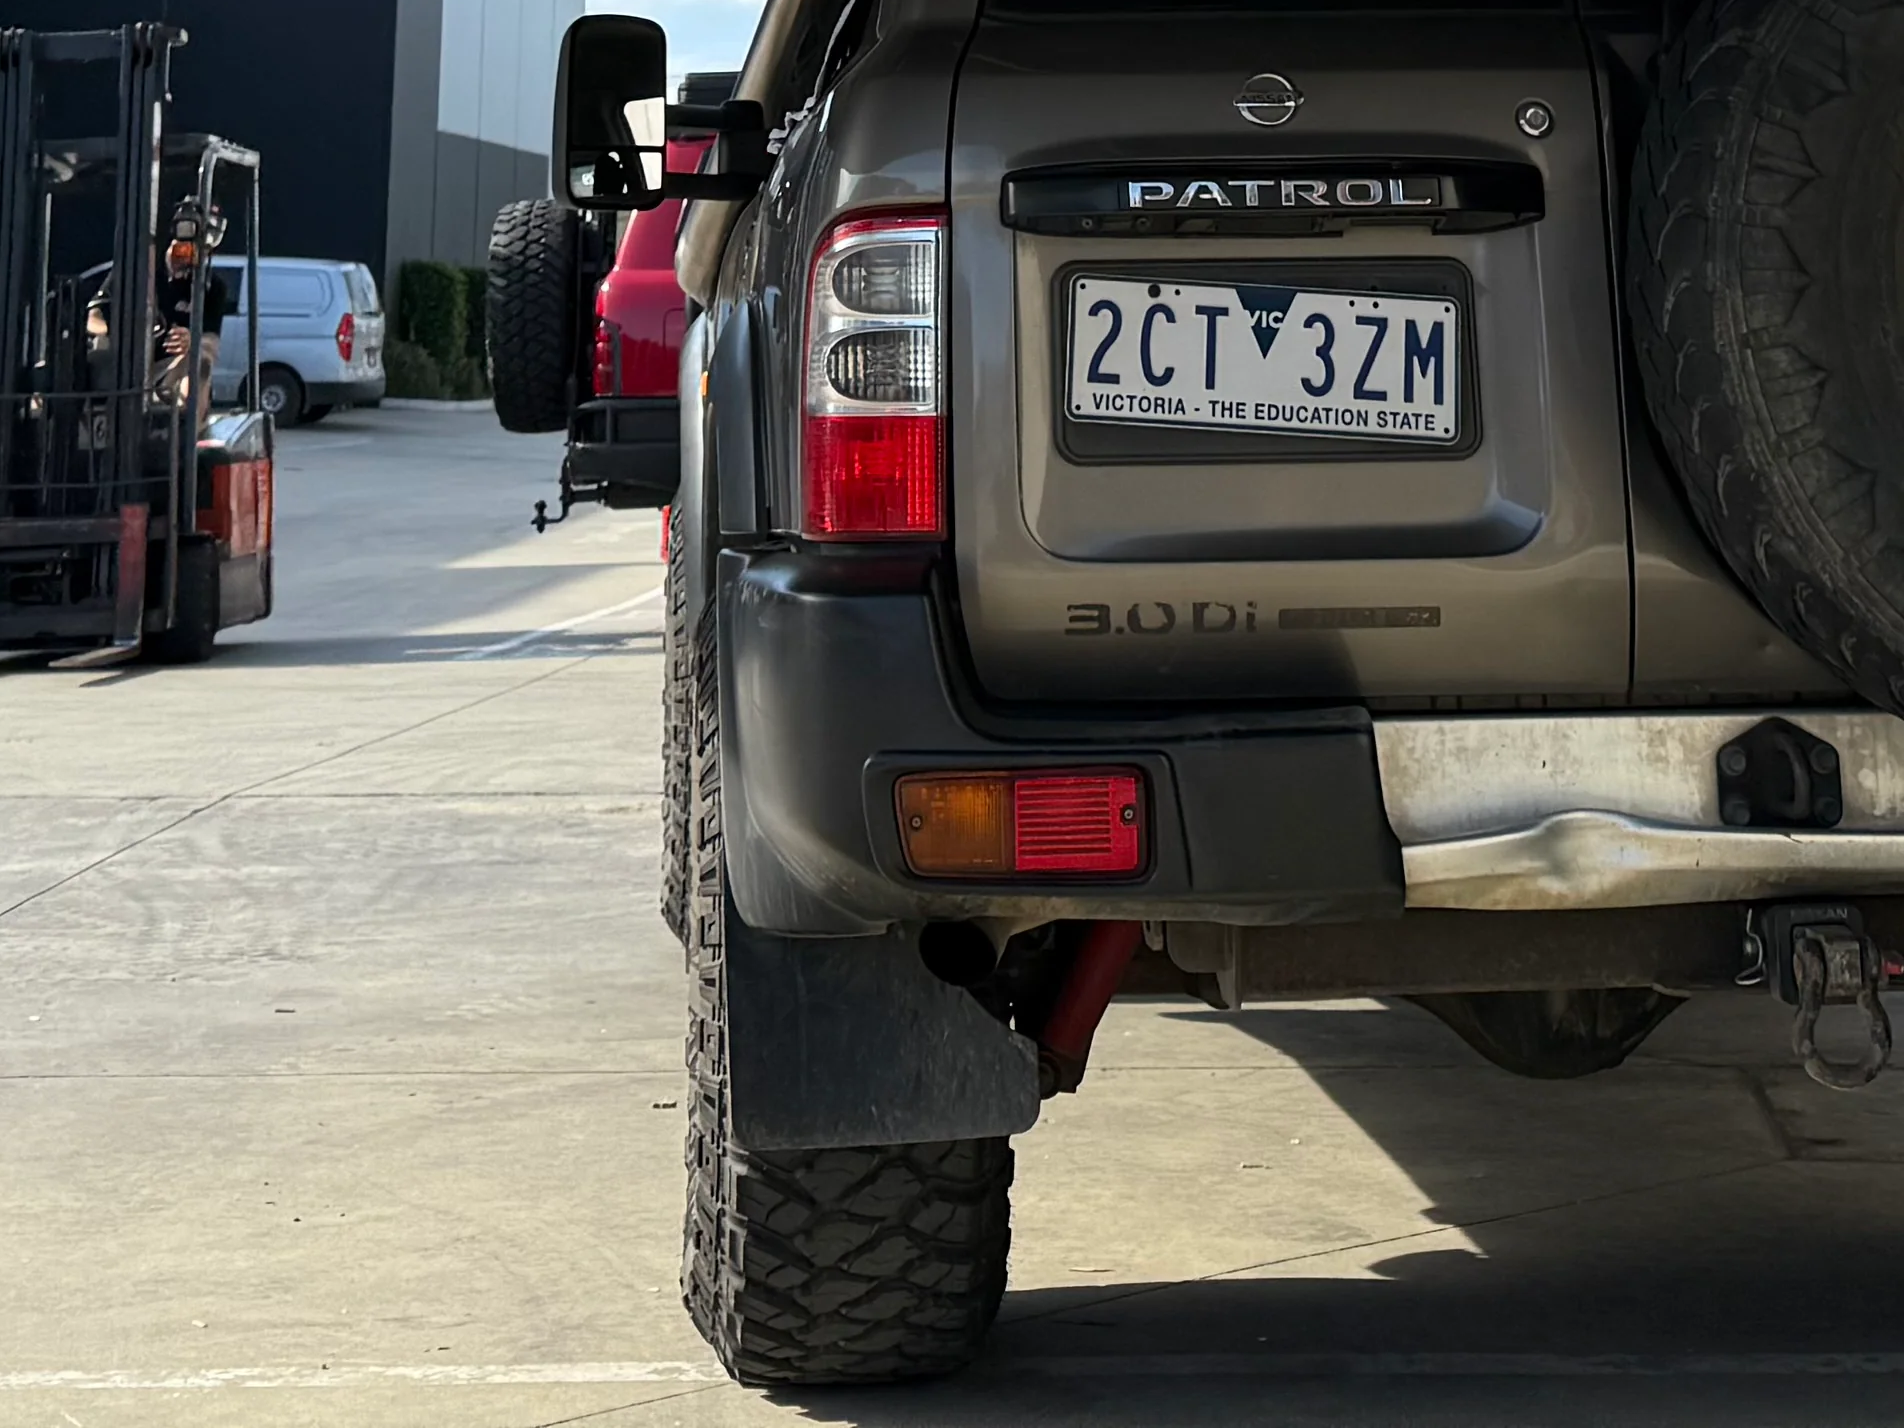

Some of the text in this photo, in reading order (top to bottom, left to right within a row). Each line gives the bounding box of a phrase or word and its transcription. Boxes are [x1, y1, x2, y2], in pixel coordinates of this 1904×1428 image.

[1128, 178, 1432, 208] PATROL
[1247, 308, 1285, 329] VIC
[1087, 299, 1445, 406] 2CT 3ZM
[1092, 392, 1186, 416] VICTORIA
[1208, 400, 1247, 420] THE
[1254, 403, 1369, 428] EDUCATION
[1376, 410, 1437, 432] STATE
